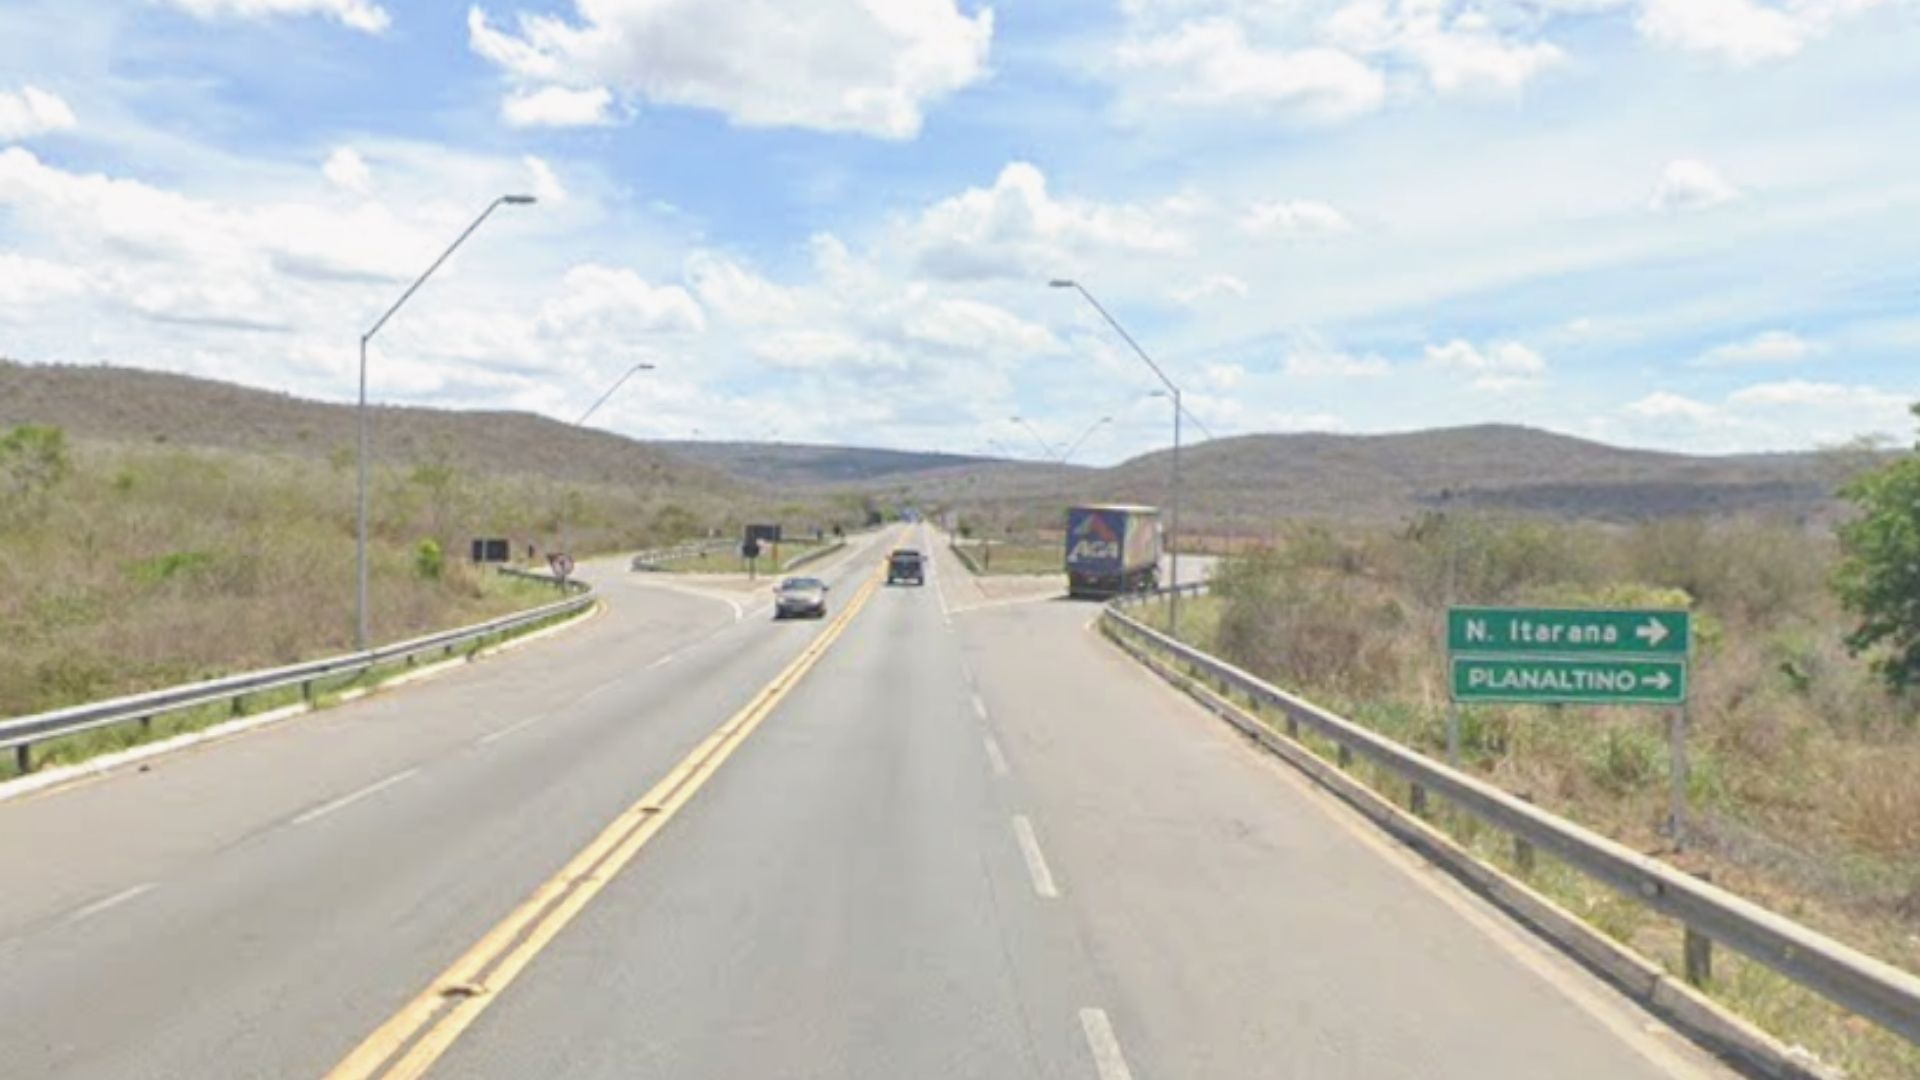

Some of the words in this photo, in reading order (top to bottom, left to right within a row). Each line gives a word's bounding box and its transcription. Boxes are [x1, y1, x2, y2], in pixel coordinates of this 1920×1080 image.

[1466, 618, 1494, 642] N.
[1510, 618, 1618, 643] Itarana
[1468, 667, 1637, 691] PLANALTINO
